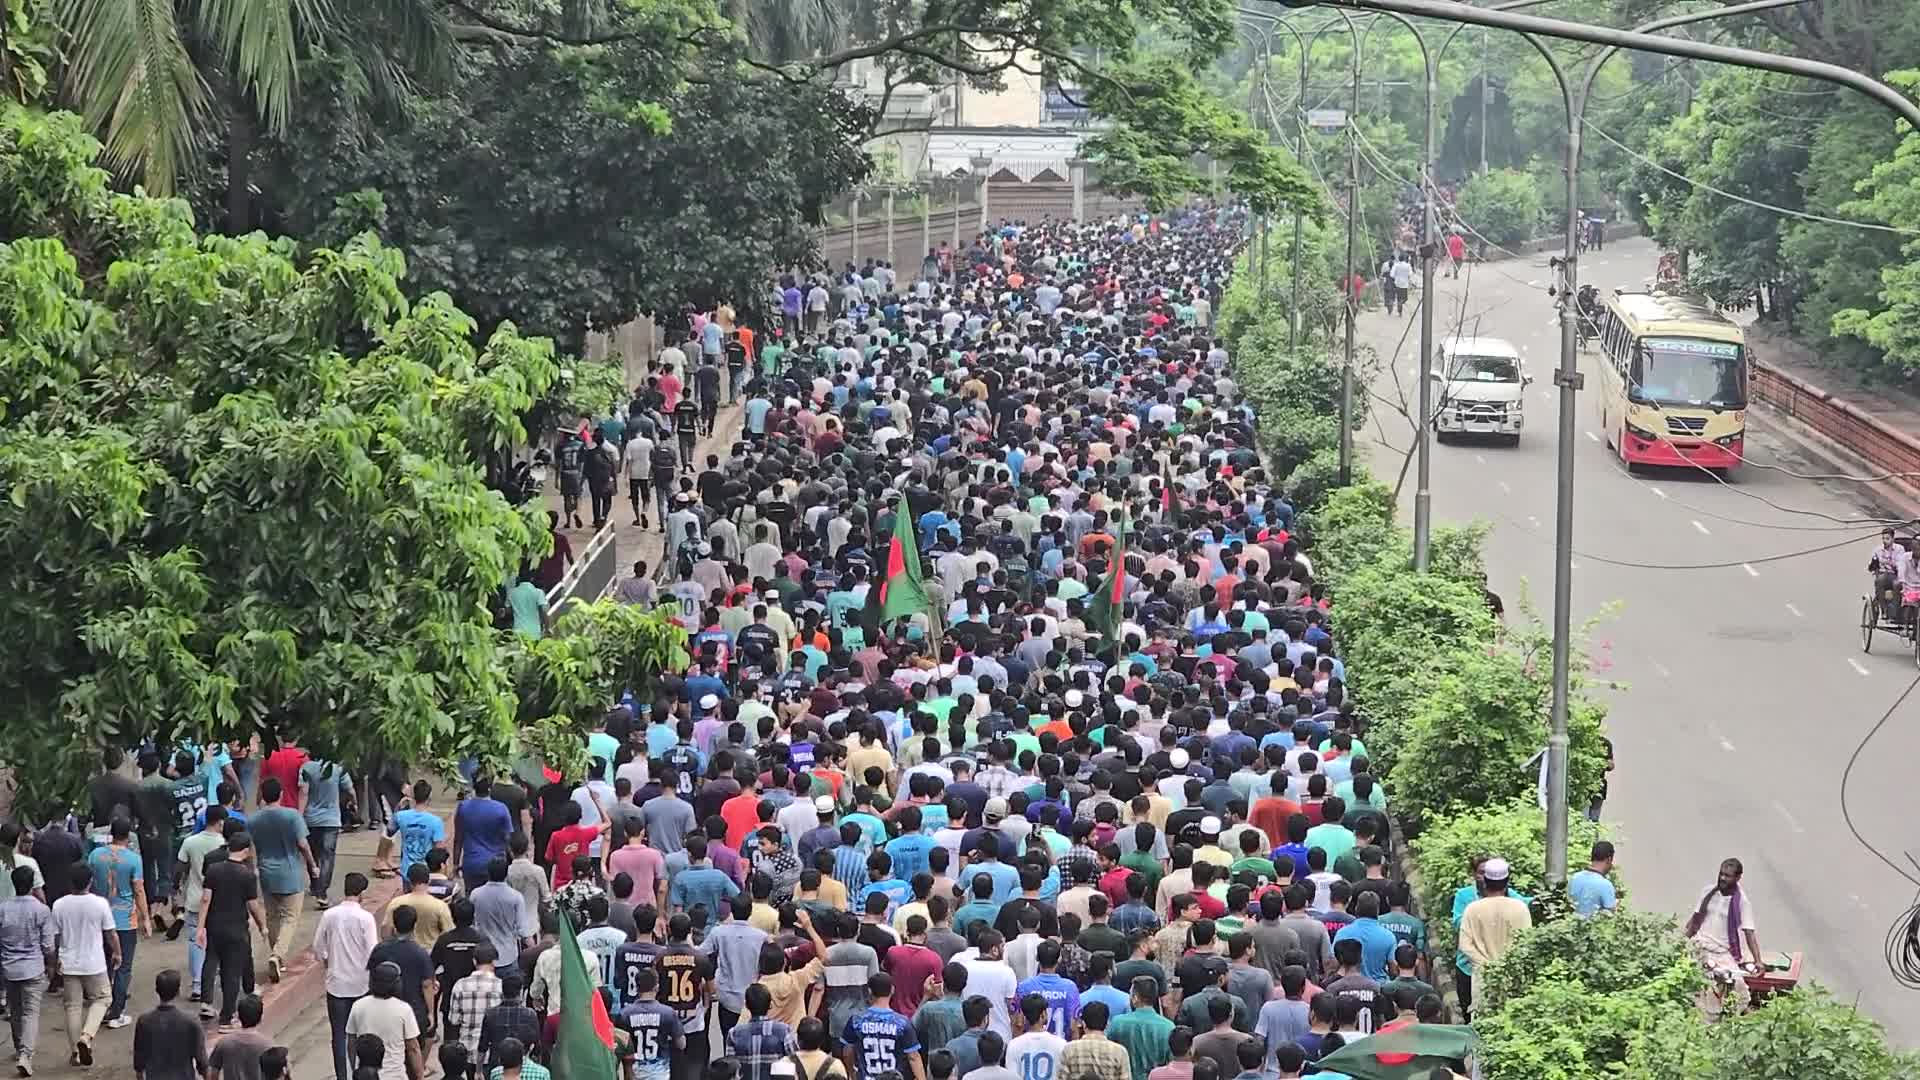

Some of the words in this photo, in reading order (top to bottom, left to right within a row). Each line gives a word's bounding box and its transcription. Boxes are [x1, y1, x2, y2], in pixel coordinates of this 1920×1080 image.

[667, 970, 694, 1002] 16
[634, 1029, 658, 1060] 15
[862, 1022, 897, 1036] OSMAN
[863, 1037, 896, 1074] 25
[1020, 1052, 1054, 1080] 10
